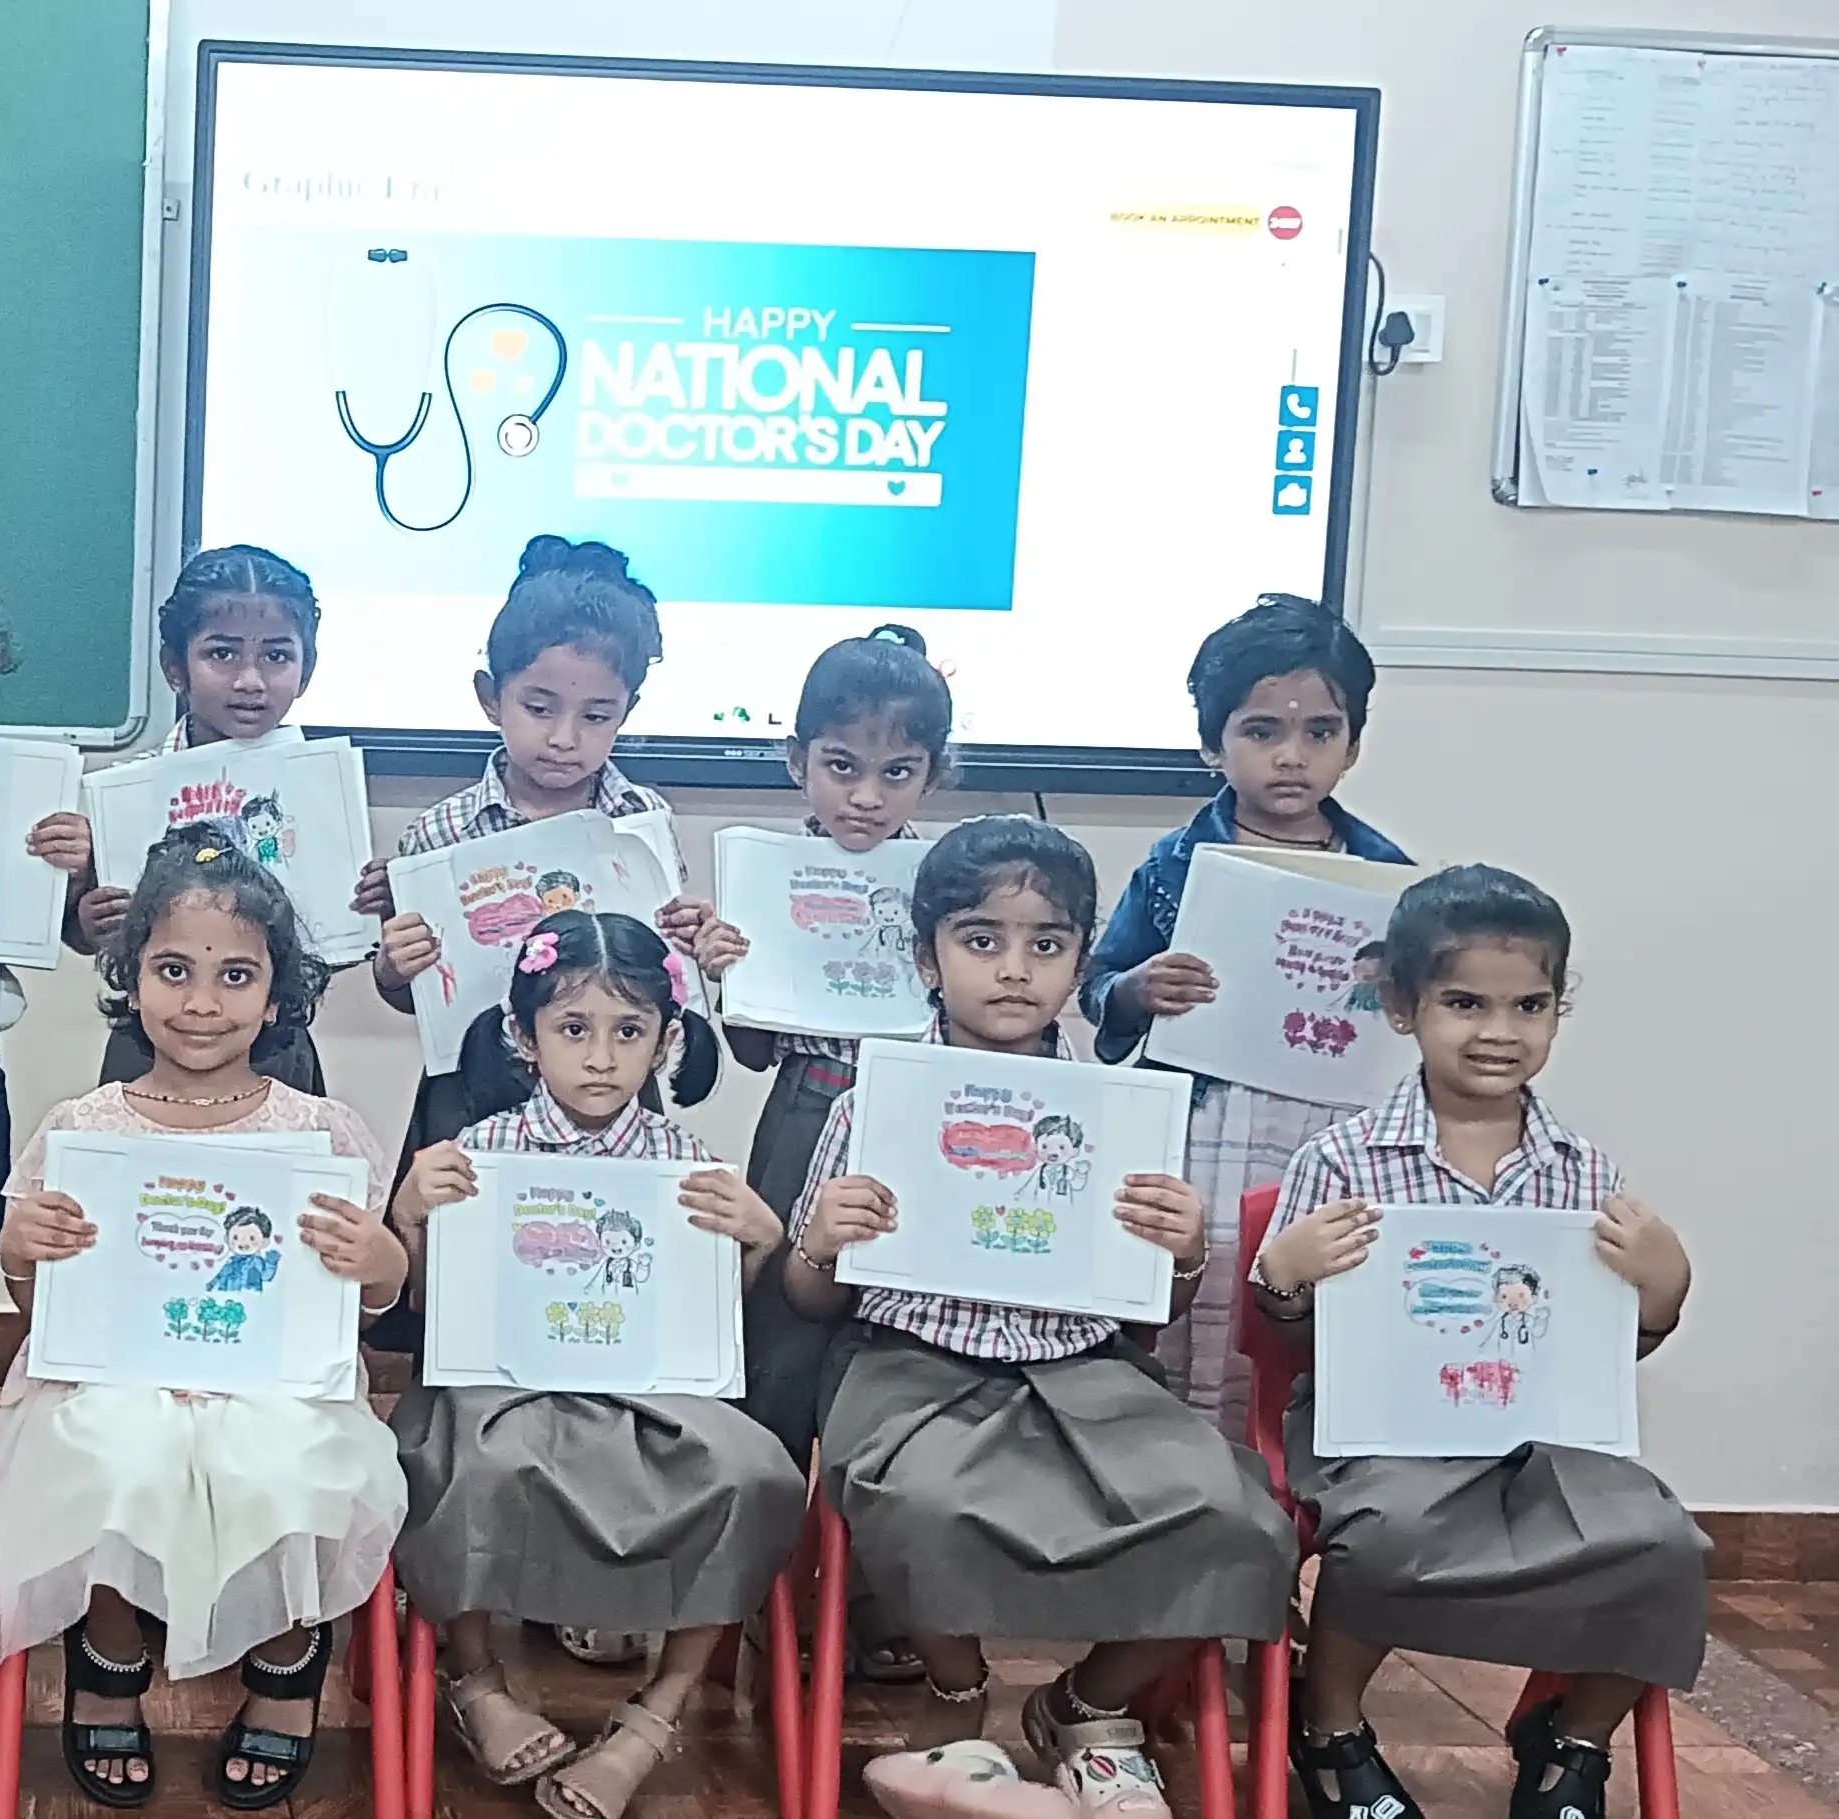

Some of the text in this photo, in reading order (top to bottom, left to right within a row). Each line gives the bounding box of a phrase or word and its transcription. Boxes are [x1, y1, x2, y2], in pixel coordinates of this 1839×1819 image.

[1111, 212, 1145, 222] BOOK
[1150, 214, 1167, 223] AN
[1171, 214, 1260, 226] APPOINTMENT
[703, 306, 837, 341] HAPPY
[580, 339, 948, 416] NATIONAL
[576, 409, 946, 467] DOCTOR'S DAY
